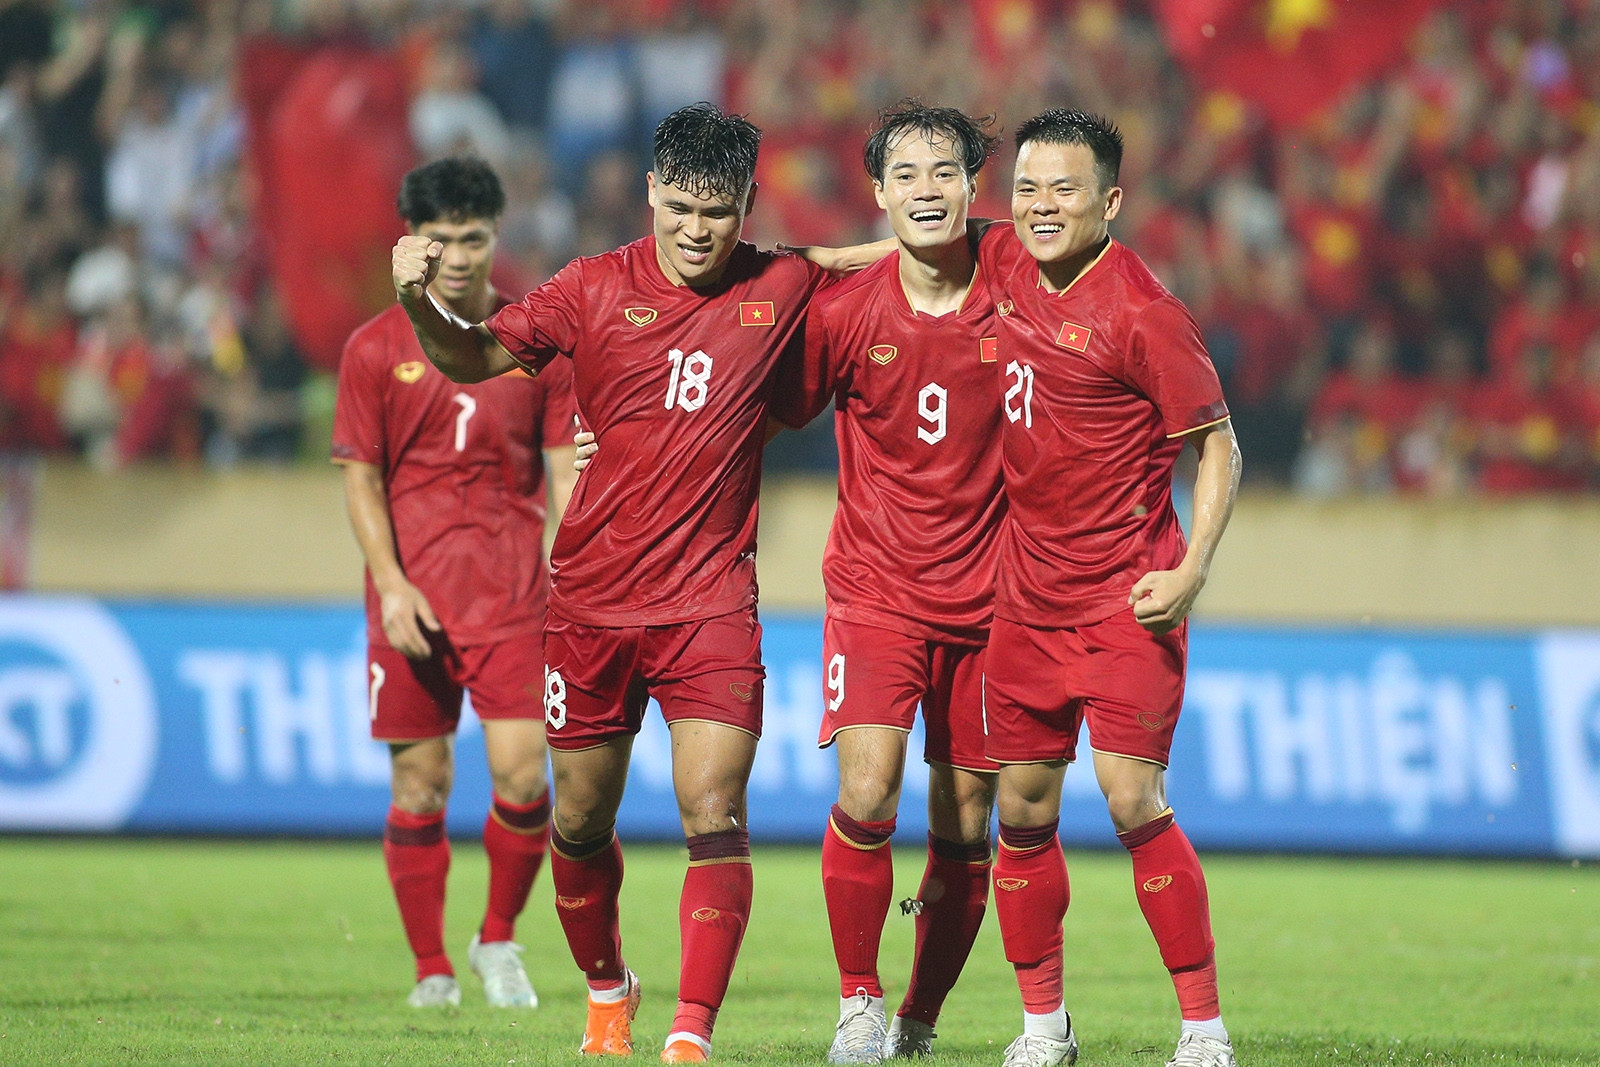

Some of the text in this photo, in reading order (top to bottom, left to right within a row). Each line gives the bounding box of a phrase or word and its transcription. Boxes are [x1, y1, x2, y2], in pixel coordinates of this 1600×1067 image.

[665, 348, 713, 412] 18
[1004, 360, 1034, 429] 21
[453, 392, 477, 452] 7
[917, 382, 948, 446] 9
[827, 652, 846, 713] 9
